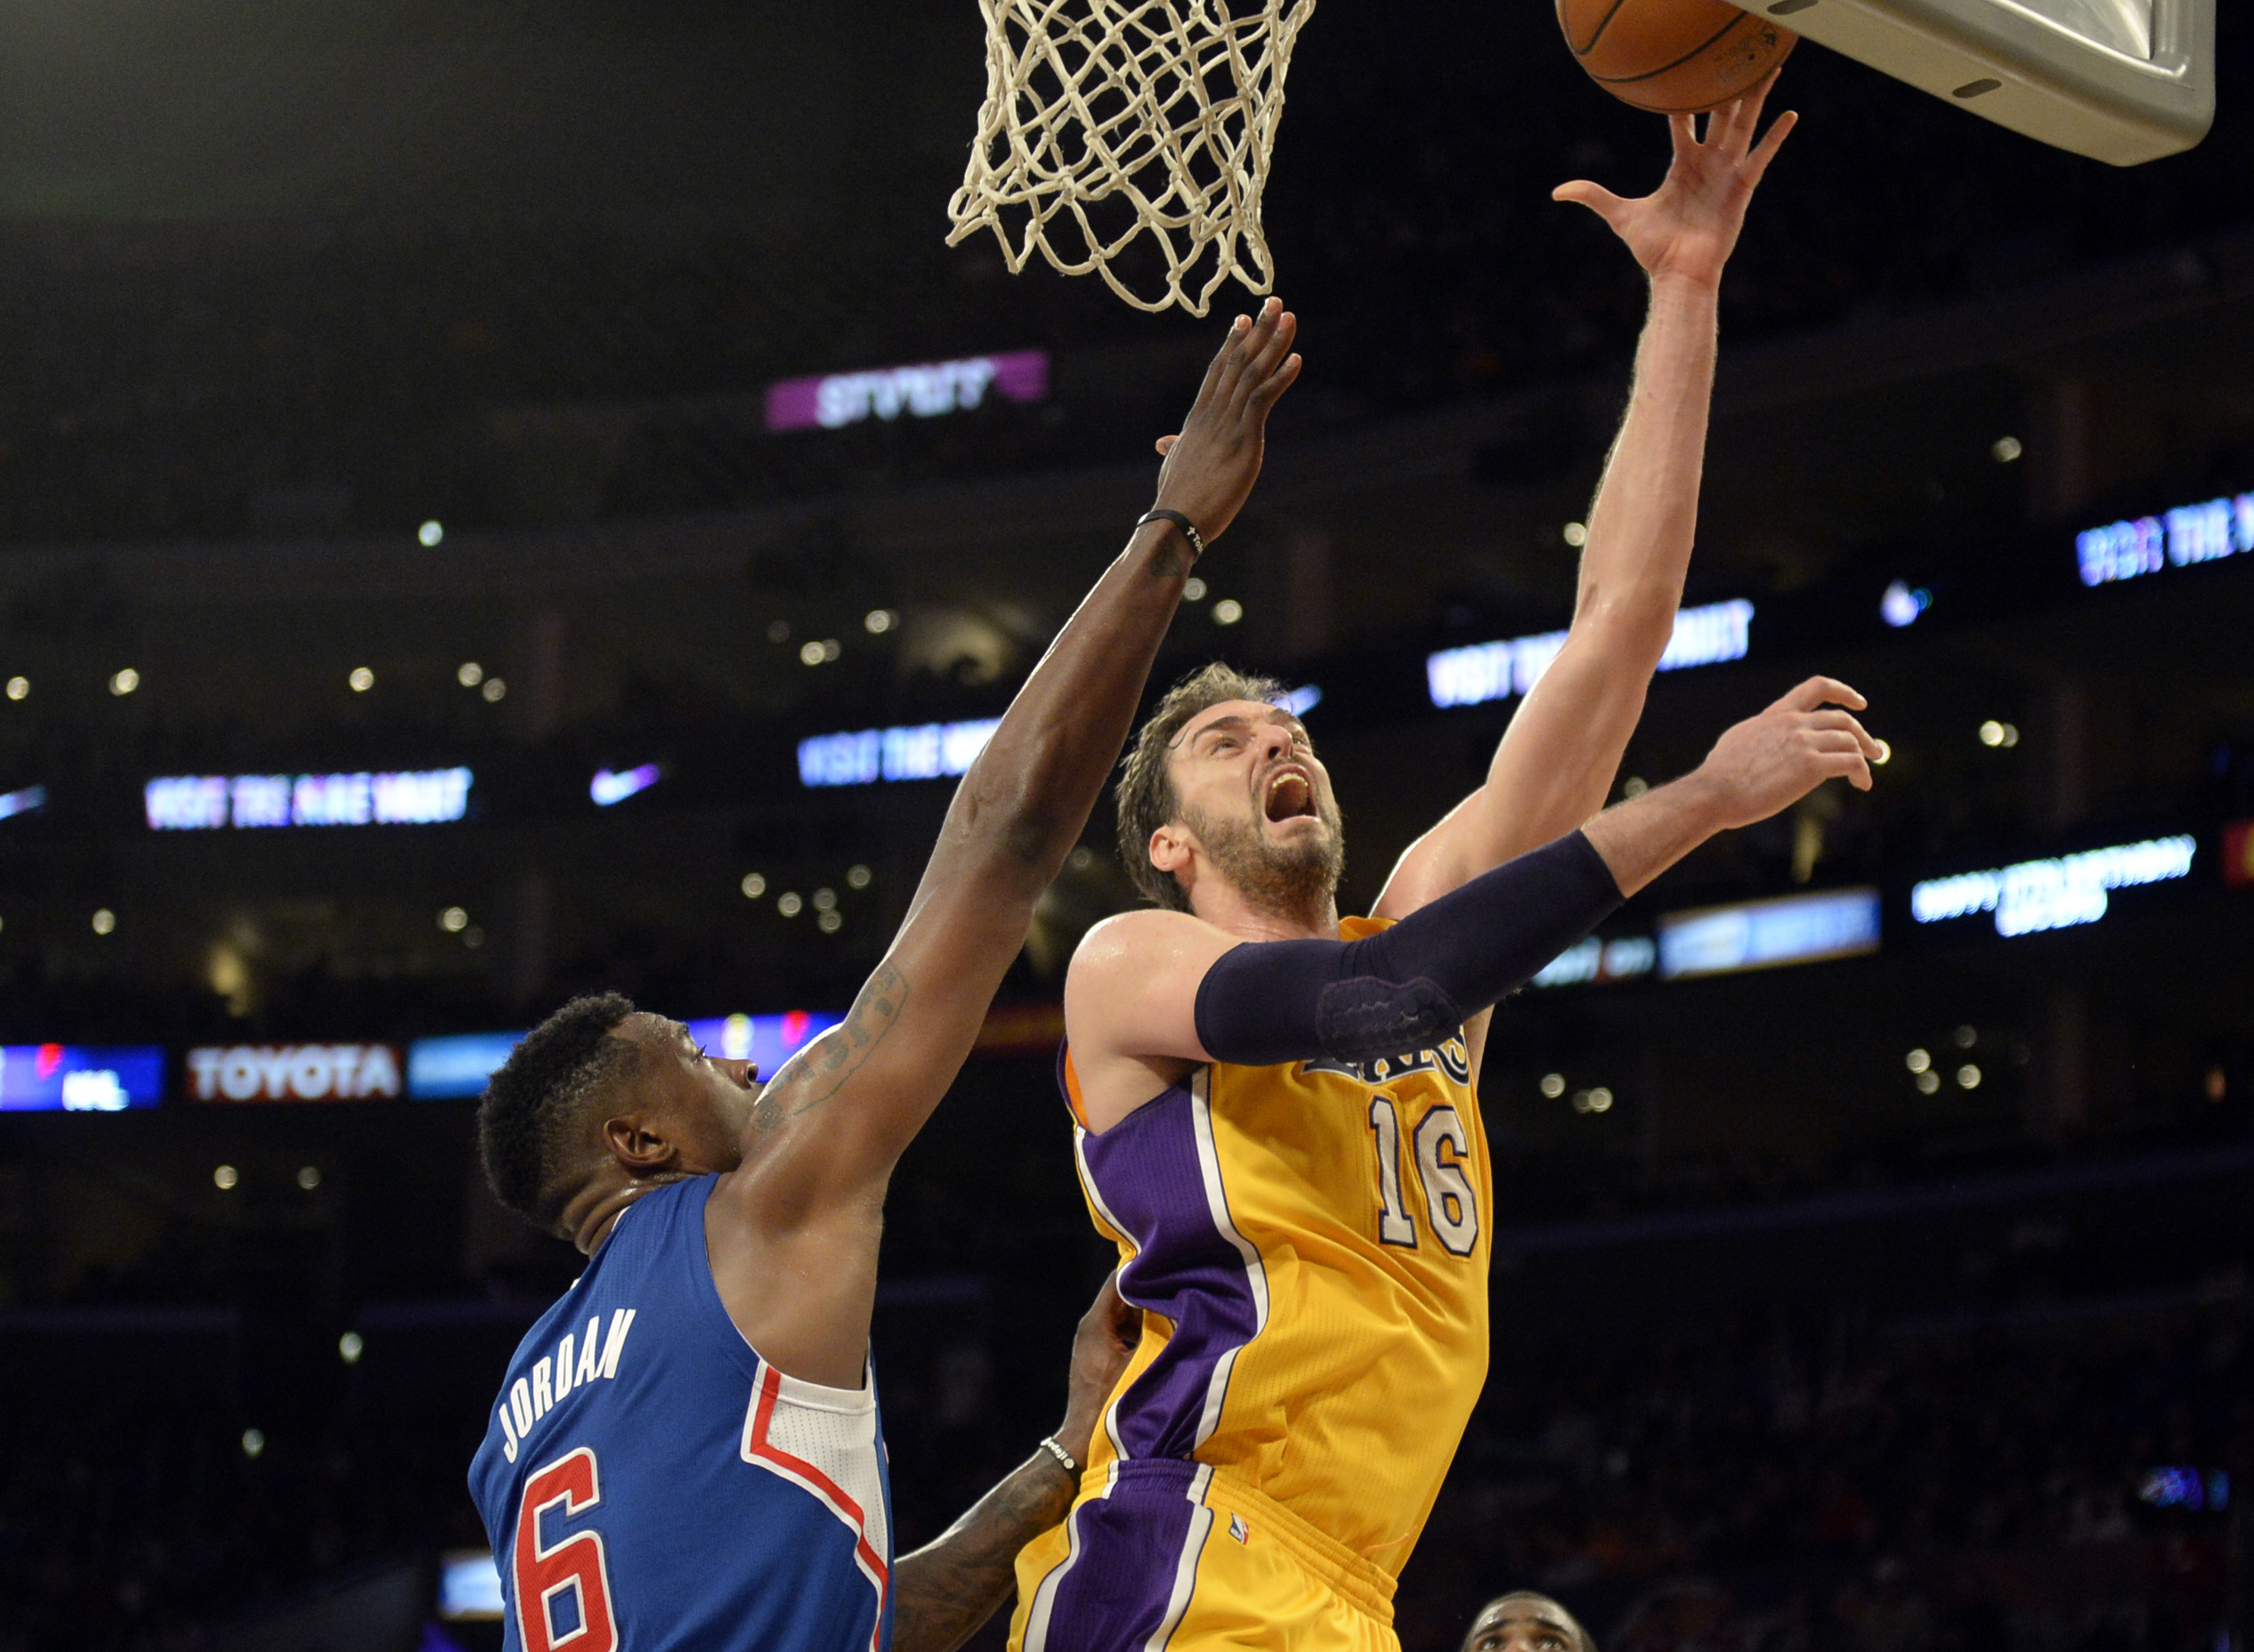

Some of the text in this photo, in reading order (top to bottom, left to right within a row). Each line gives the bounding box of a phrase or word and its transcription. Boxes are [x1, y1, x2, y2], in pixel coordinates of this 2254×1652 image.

[187, 1044, 401, 1102] TOYOTA
[1368, 1095, 1480, 1258] 16
[498, 1308, 636, 1464] JORDAN
[512, 1446, 619, 1652] 6
